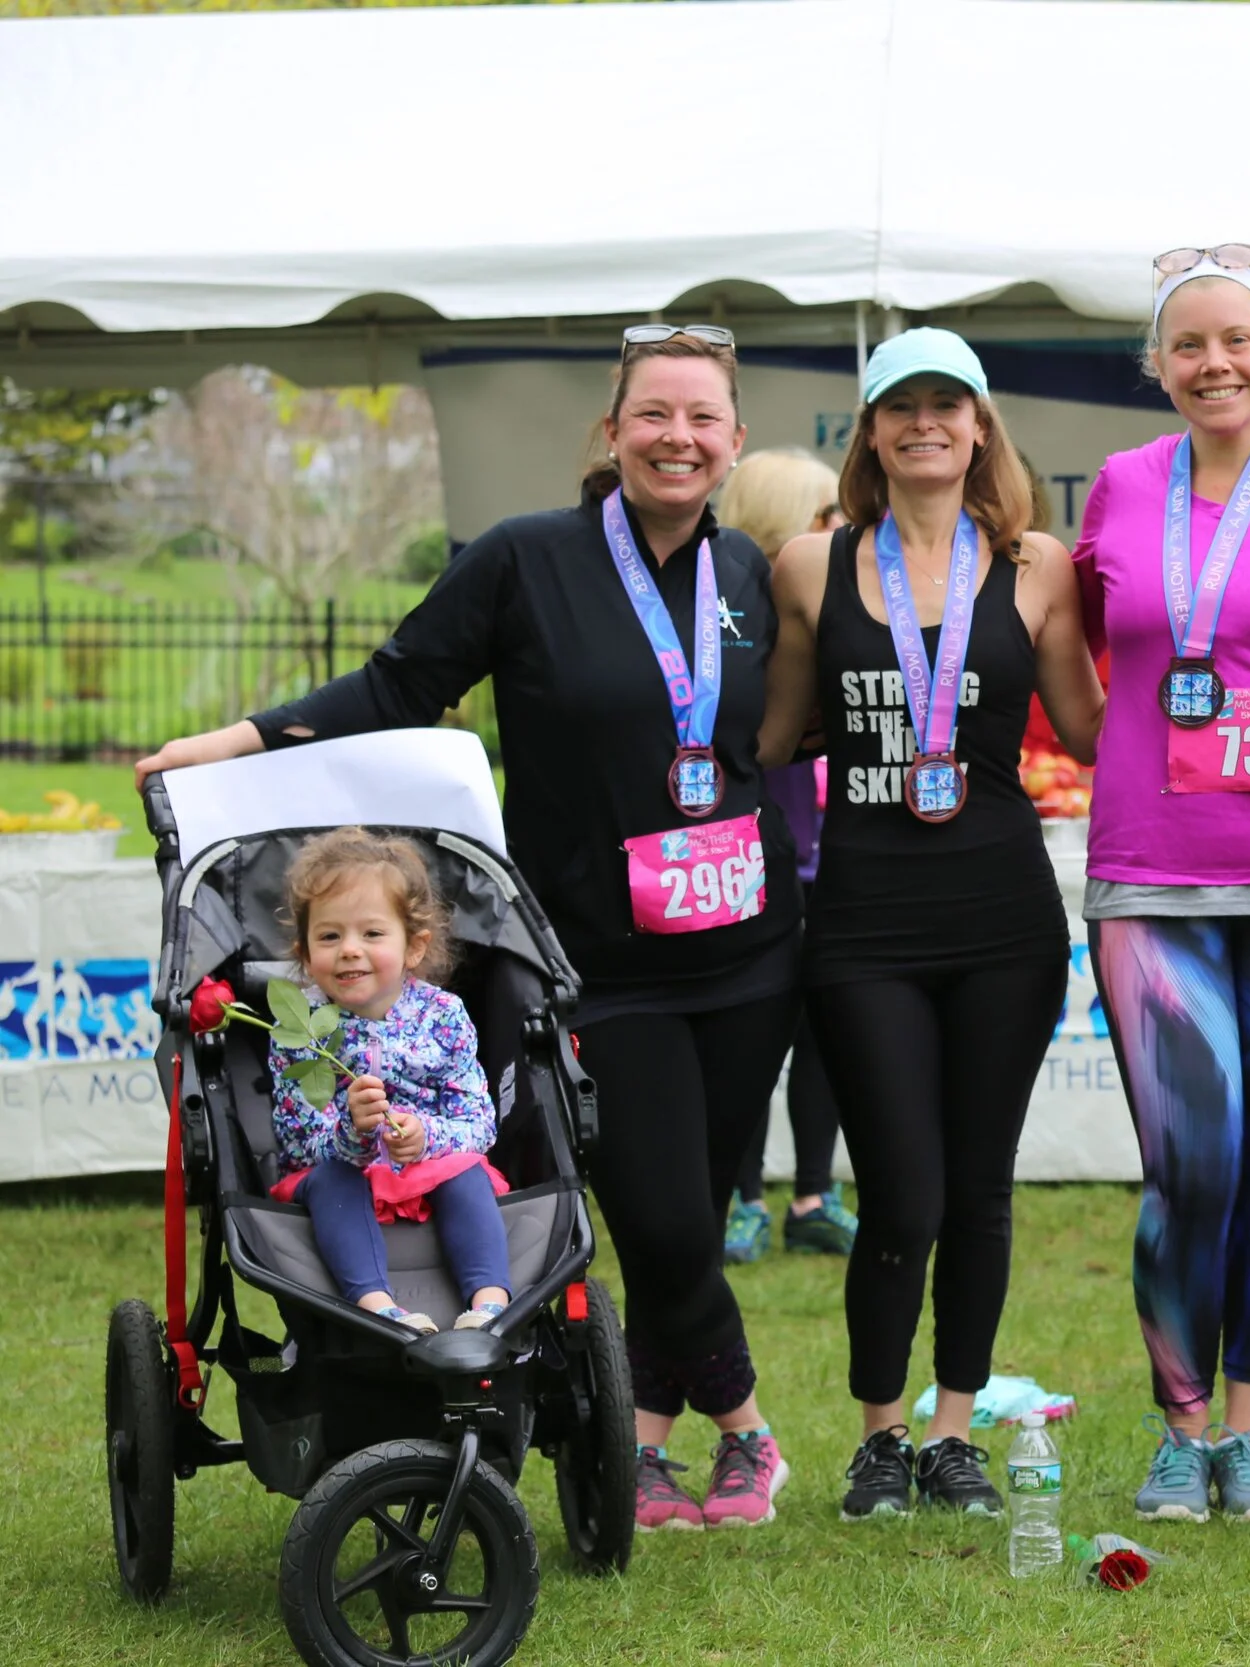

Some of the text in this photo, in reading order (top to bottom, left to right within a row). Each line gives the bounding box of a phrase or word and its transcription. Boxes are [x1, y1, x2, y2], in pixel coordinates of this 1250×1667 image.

[1172, 486, 1185, 513] RUN
[614, 533, 649, 595] MOTHER
[1171, 547, 1182, 558] A
[1204, 561, 1226, 591] RUN
[1218, 531, 1237, 560] LIKE
[1228, 517, 1243, 529] A
[940, 543, 972, 687] RUN LIKE A MOTHER
[1170, 561, 1189, 624] MOTHER
[702, 616, 716, 681] MOTHER
[887, 569, 930, 719] RUN LIKE A MOTHER
[841, 671, 980, 707] STRG
[846, 711, 904, 733] IS THE
[689, 832, 734, 849] MOTHER
[660, 857, 746, 919] 296
[42, 1074, 73, 1105] A
[1045, 1057, 1117, 1091] THE
